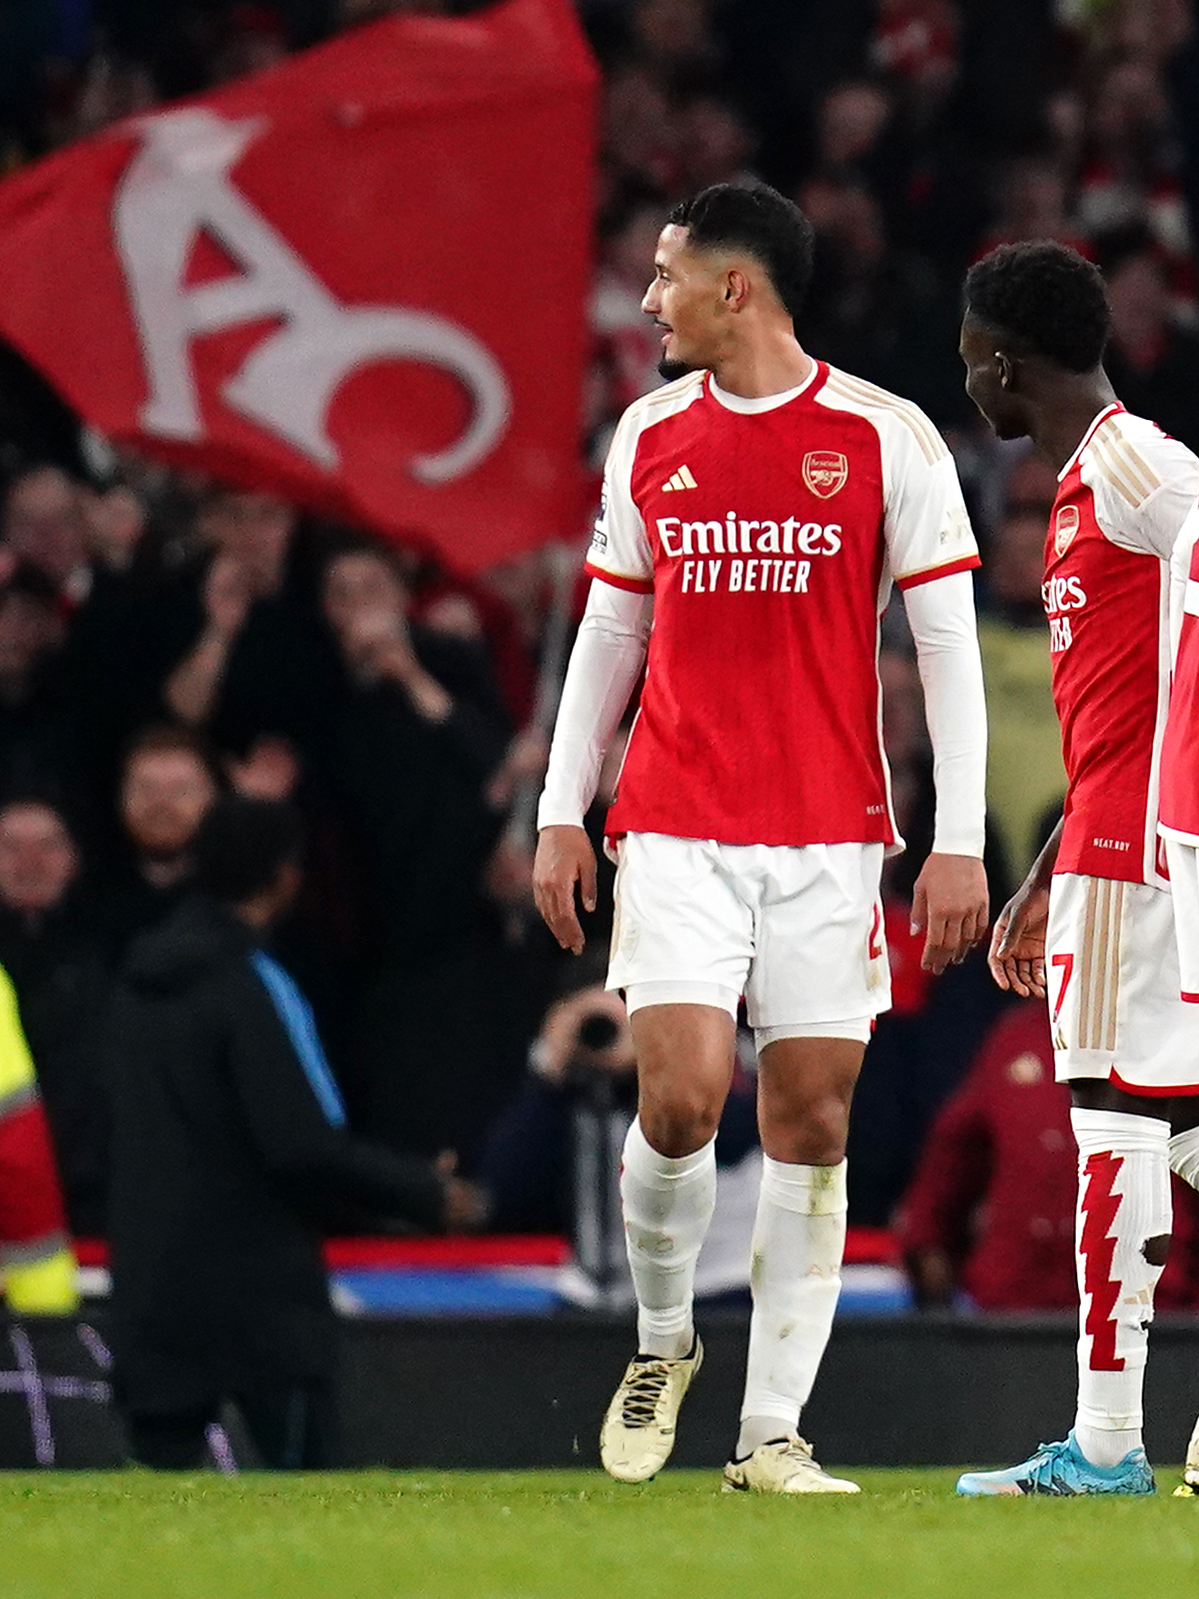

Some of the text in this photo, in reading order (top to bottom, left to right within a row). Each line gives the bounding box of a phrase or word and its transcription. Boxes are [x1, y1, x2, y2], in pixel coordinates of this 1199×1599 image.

[655, 510, 842, 558] Emirates
[681, 558, 811, 594] FLY BETTER
[1051, 953, 1075, 1023] 7
